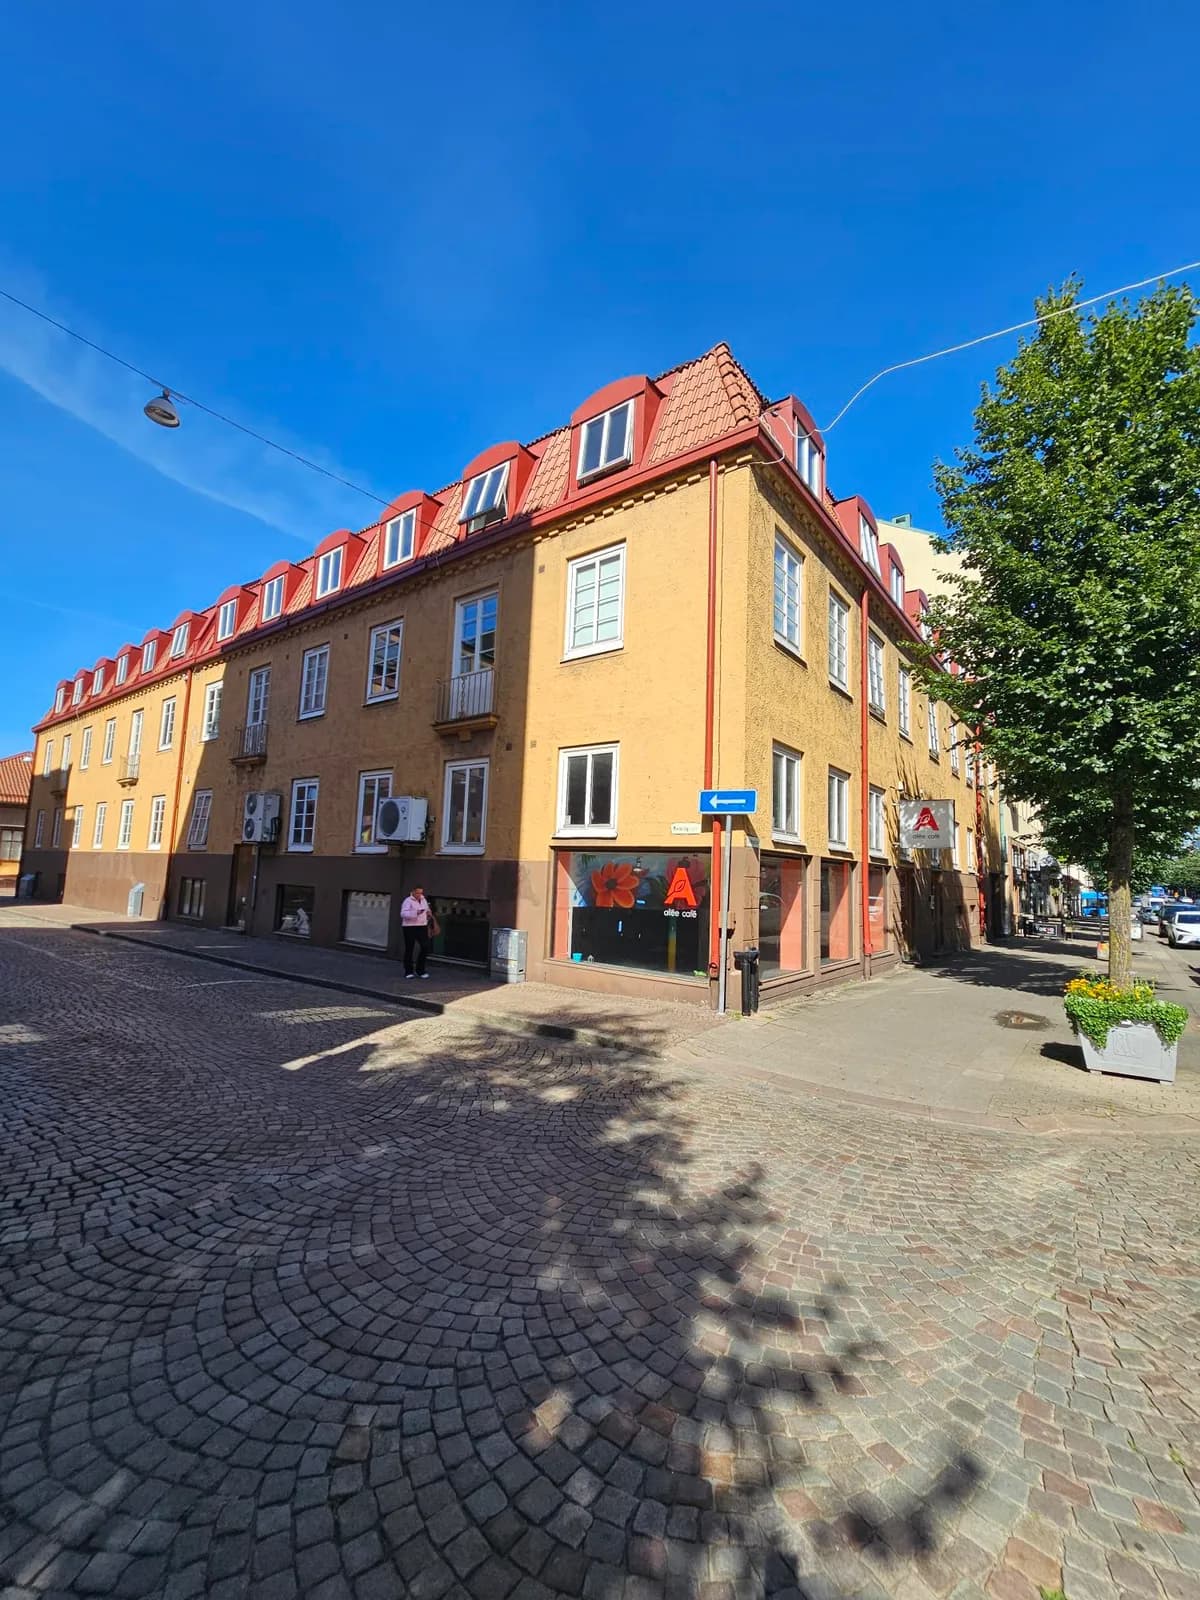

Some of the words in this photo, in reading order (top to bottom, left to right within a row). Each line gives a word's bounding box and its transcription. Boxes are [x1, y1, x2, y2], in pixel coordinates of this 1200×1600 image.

[913, 807, 939, 831] A
[664, 867, 697, 906] A
[681, 909, 697, 918] café
